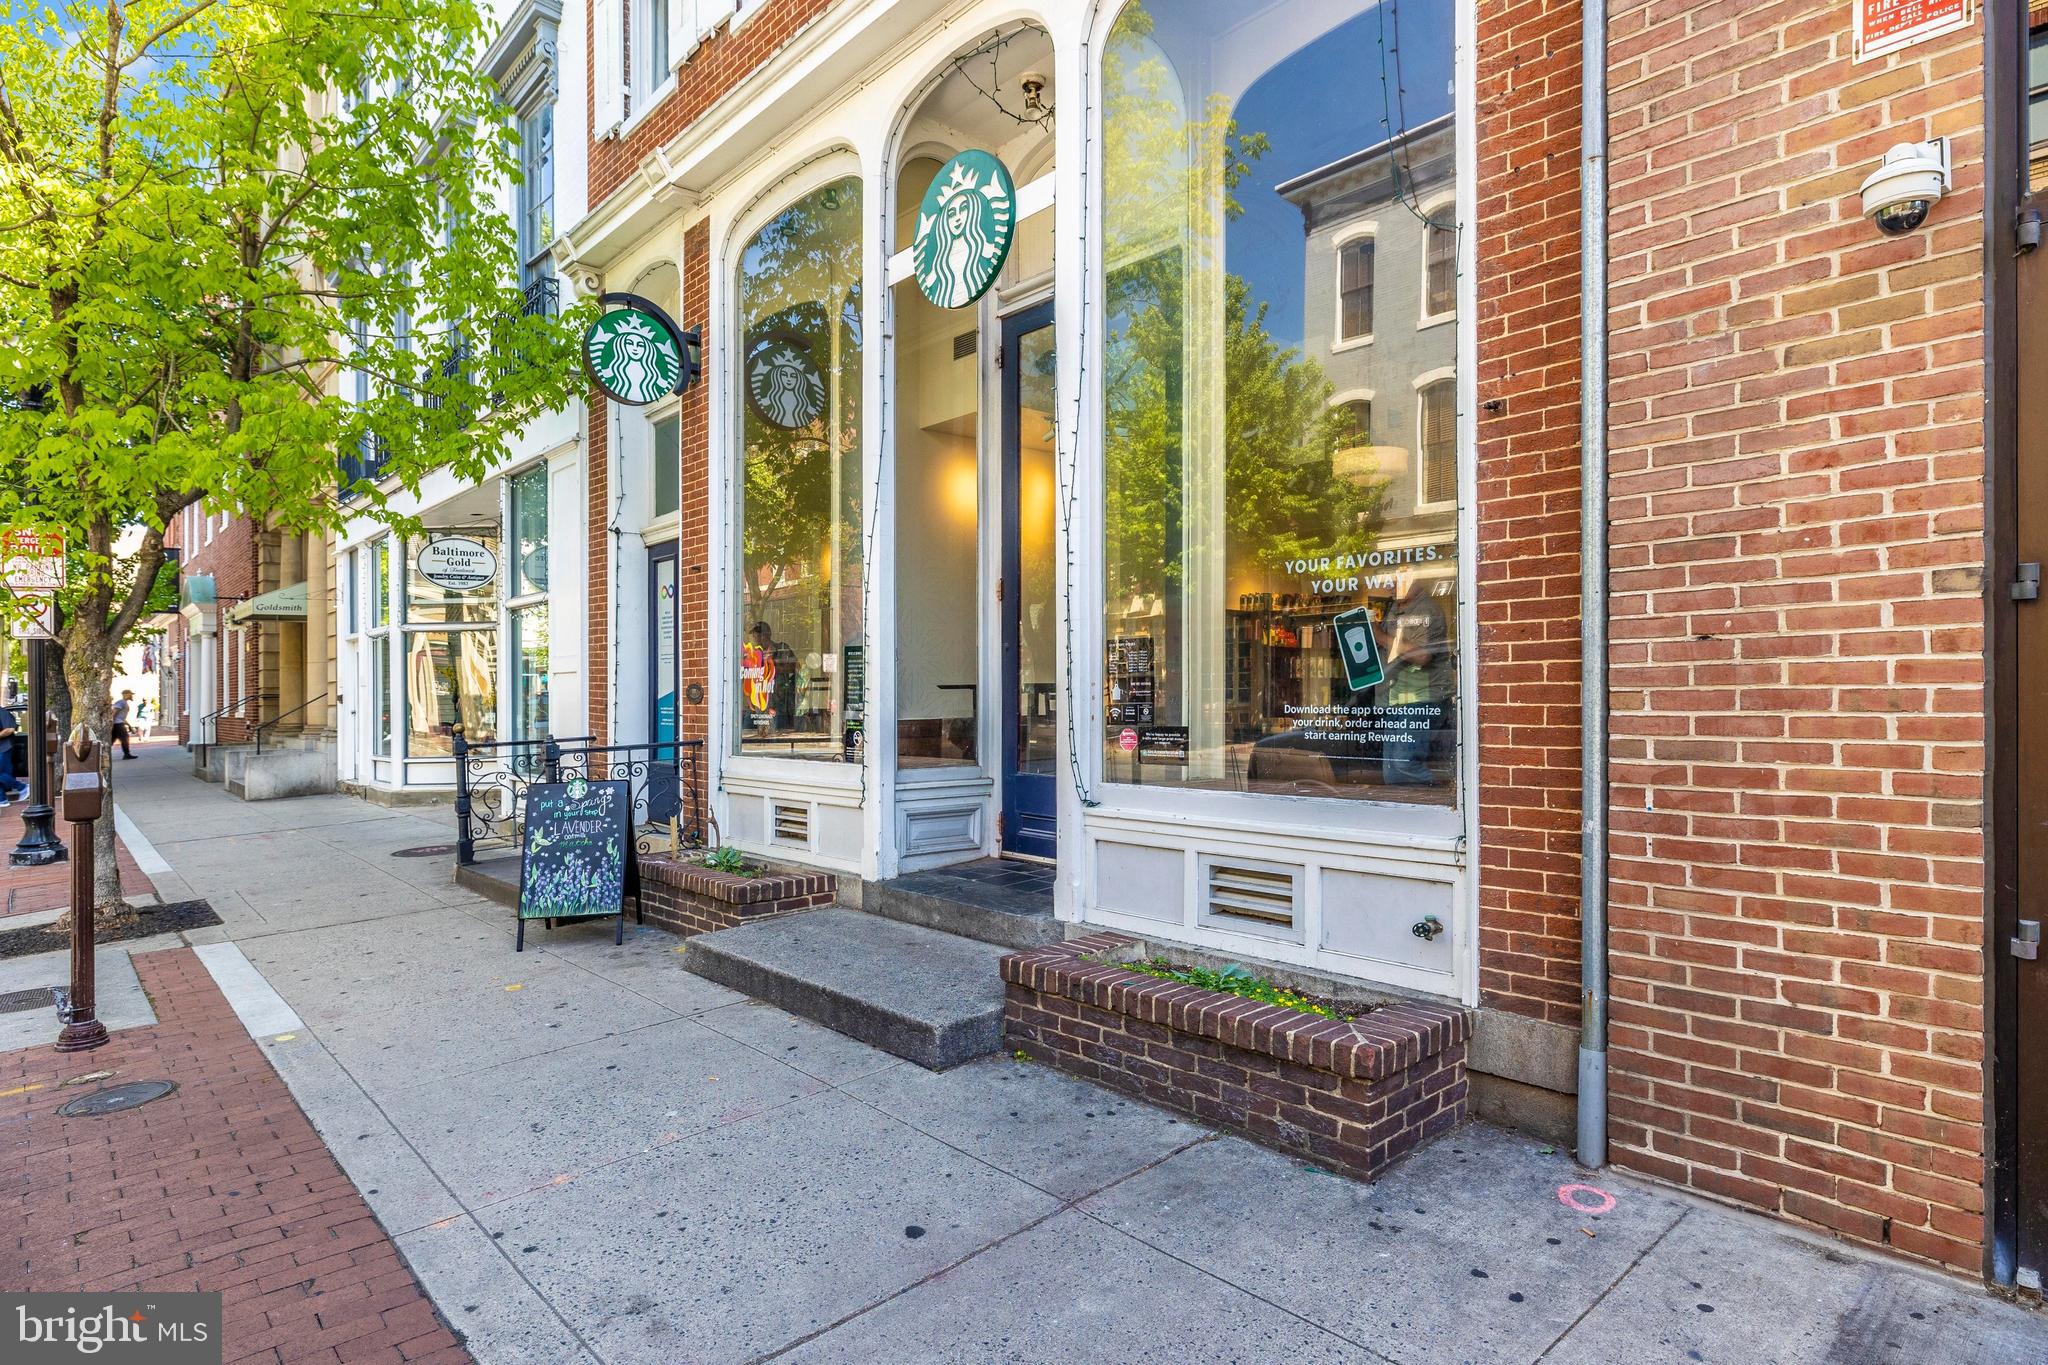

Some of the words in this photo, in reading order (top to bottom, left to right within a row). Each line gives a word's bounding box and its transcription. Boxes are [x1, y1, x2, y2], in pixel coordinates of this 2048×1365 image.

[1865, 29, 1886, 40] FIRE
[1926, 3, 1960, 19] POLICE
[1868, 13, 1895, 27] WHEN
[1900, 3, 1923, 16] BELL
[1901, 10, 1923, 22] CALL
[432, 546, 485, 557] Baltimore
[446, 557, 471, 567] Gold
[1285, 557, 1330, 575] YOUR
[1336, 546, 1443, 570] FAVORITES.
[1311, 577, 1359, 594] YOUR
[256, 603, 303, 612] Goldsmith
[740, 665, 765, 681] Coming
[1284, 704, 1331, 715] Download
[1333, 704, 1350, 715] the
[1352, 707, 1371, 717] app
[1373, 705, 1384, 715] to
[1385, 703, 1441, 716] customize
[1292, 719, 1314, 728] your
[1315, 715, 1344, 729] drink,
[1345, 717, 1373, 728] order
[1375, 718, 1407, 729] ahead
[1410, 719, 1430, 730] and
[1304, 731, 1327, 741] start
[1328, 731, 1366, 743] earning
[1368, 732, 1416, 743] Rewards.
[540, 800, 553, 811] put
[557, 799, 564, 808] a
[570, 795, 612, 816] Spring
[553, 810, 562, 818] in
[563, 810, 579, 820] your
[554, 820, 603, 836] LAVENDER
